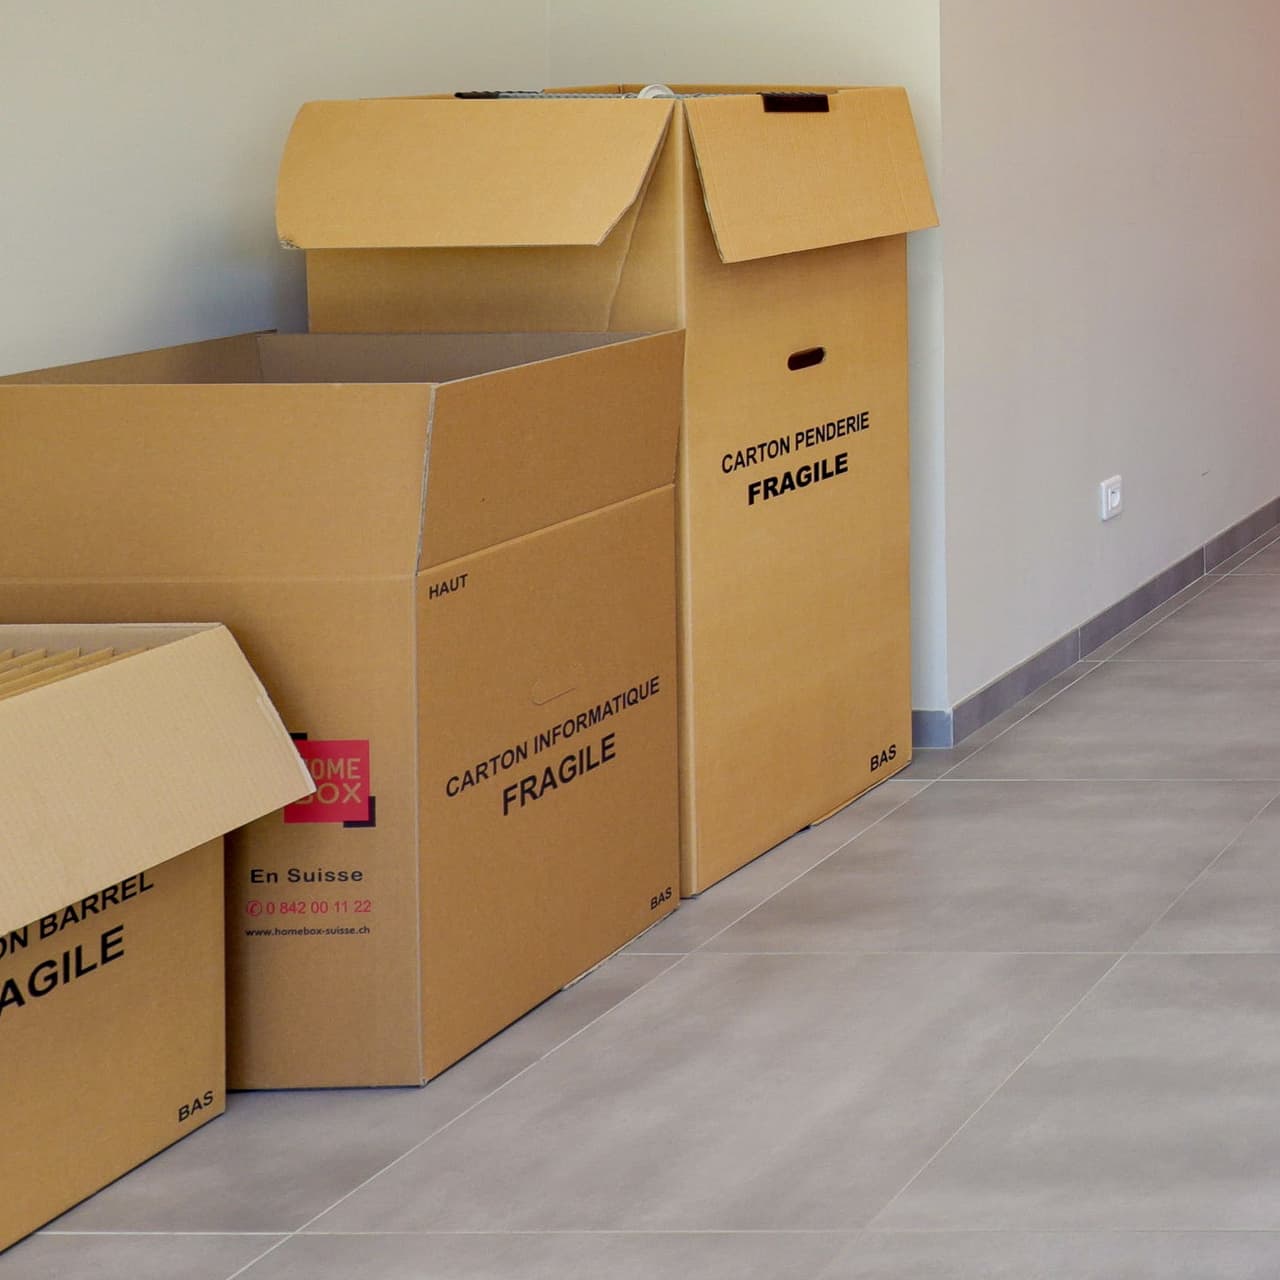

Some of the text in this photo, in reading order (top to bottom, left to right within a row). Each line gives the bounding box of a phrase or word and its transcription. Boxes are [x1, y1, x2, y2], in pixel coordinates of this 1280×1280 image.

[721, 411, 870, 474] CARTON PENDERIE
[748, 452, 849, 506] FRAGILE
[429, 573, 468, 600] HAUT
[446, 675, 660, 797] CARTON INFORMATIQUE
[306, 757, 362, 781] OME
[870, 744, 897, 773] BAS
[502, 733, 617, 816] FRAGILE
[250, 868, 363, 884] En Suisse
[39, 871, 154, 940] BARREL
[266, 899, 371, 915] 0 842 00 11 22
[650, 886, 672, 910] BAS
[245, 926, 371, 937] www.homebox-suisse.ch
[178, 1090, 214, 1122] BAS
